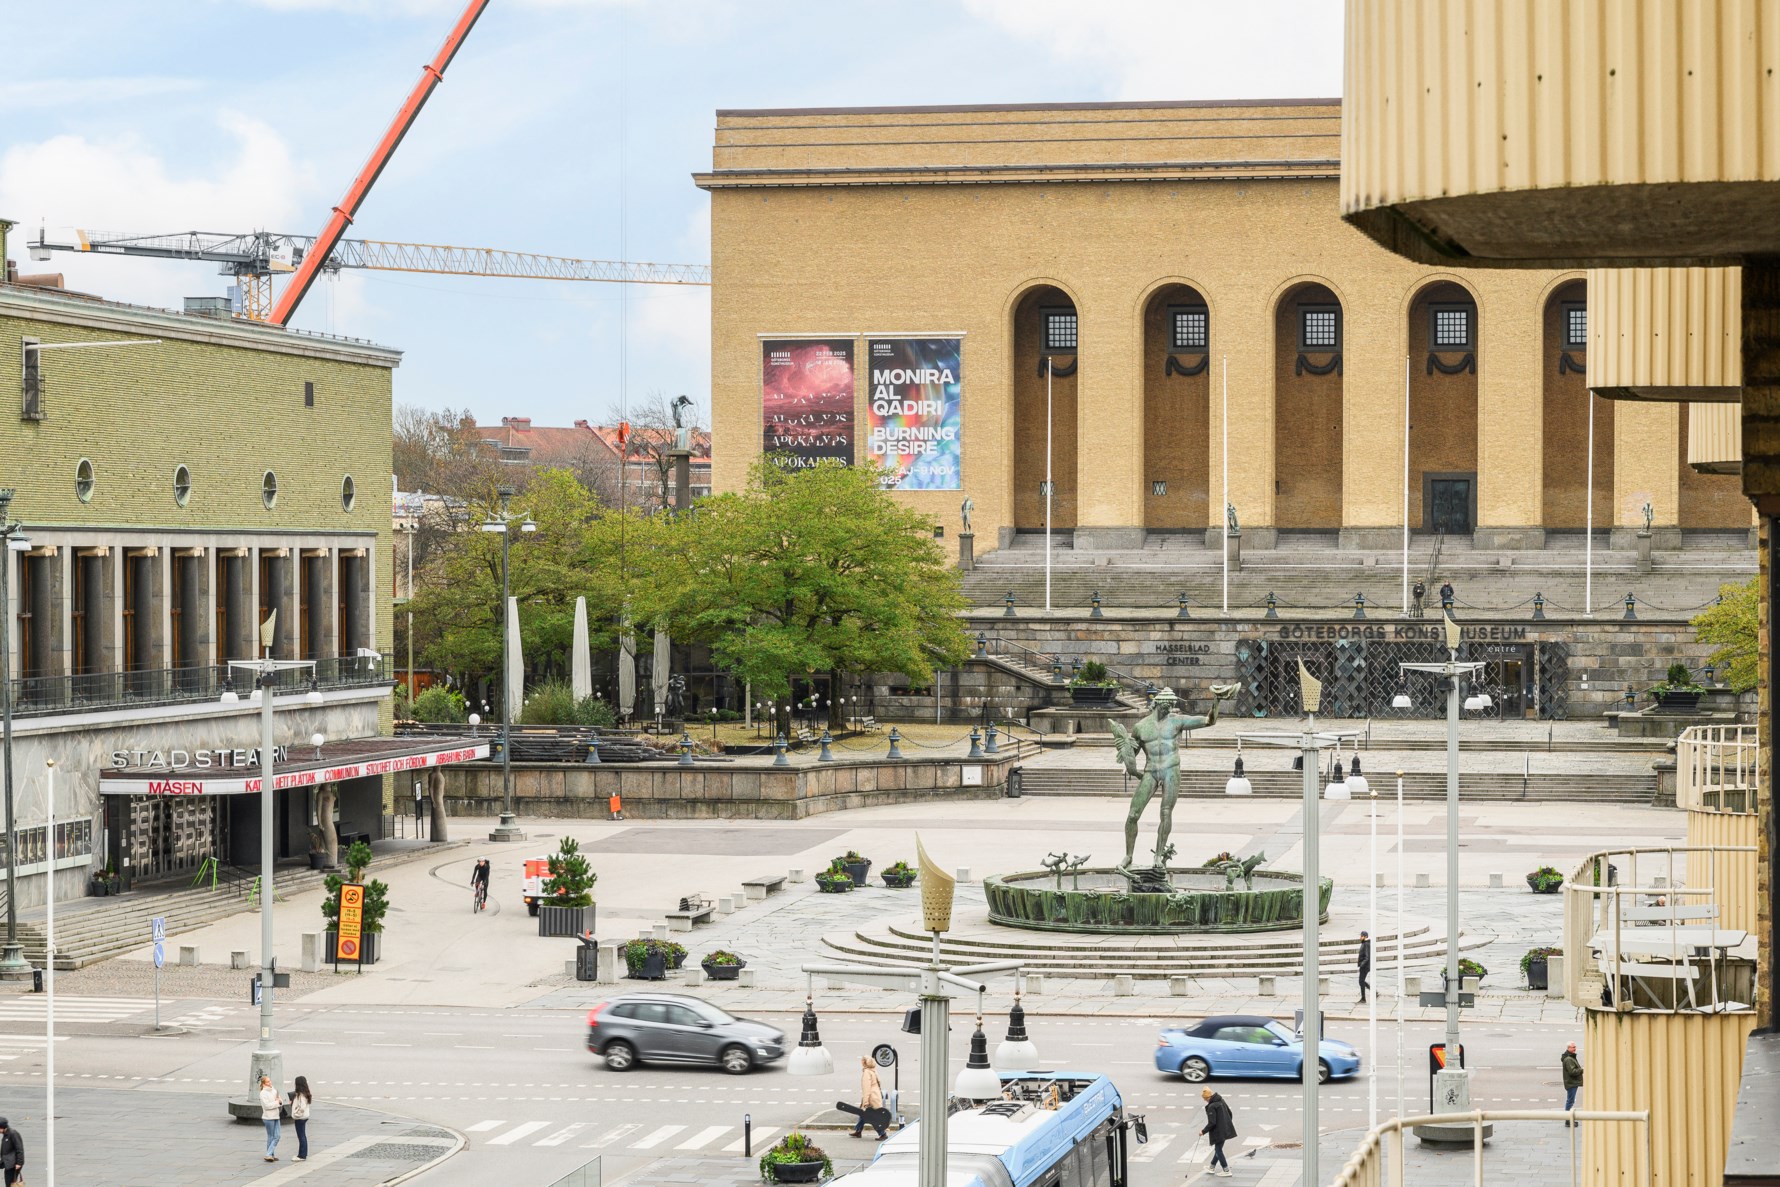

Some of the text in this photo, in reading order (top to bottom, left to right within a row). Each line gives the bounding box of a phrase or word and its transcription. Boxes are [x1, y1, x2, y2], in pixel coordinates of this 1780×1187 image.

[873, 369, 955, 385] MONIRA
[873, 385, 901, 400] AL
[873, 400, 942, 416] QADIRI
[873, 426, 955, 440] BURNING
[873, 441, 938, 455] DESIRE
[929, 466, 954, 475] NOV
[877, 476, 902, 485] 025
[1279, 624, 1527, 640] GÖTEBORGS KONSUSEUM
[1155, 644, 1210, 653] HASSELBLAD
[1487, 645, 1516, 653] entré
[1166, 656, 1200, 665] CENTER
[112, 746, 288, 767] STADSTEARN
[393, 758, 404, 771] OCH
[324, 766, 360, 782] COMMUNION
[148, 779, 203, 795] MÅSEN
[275, 774, 289, 789] HETT
